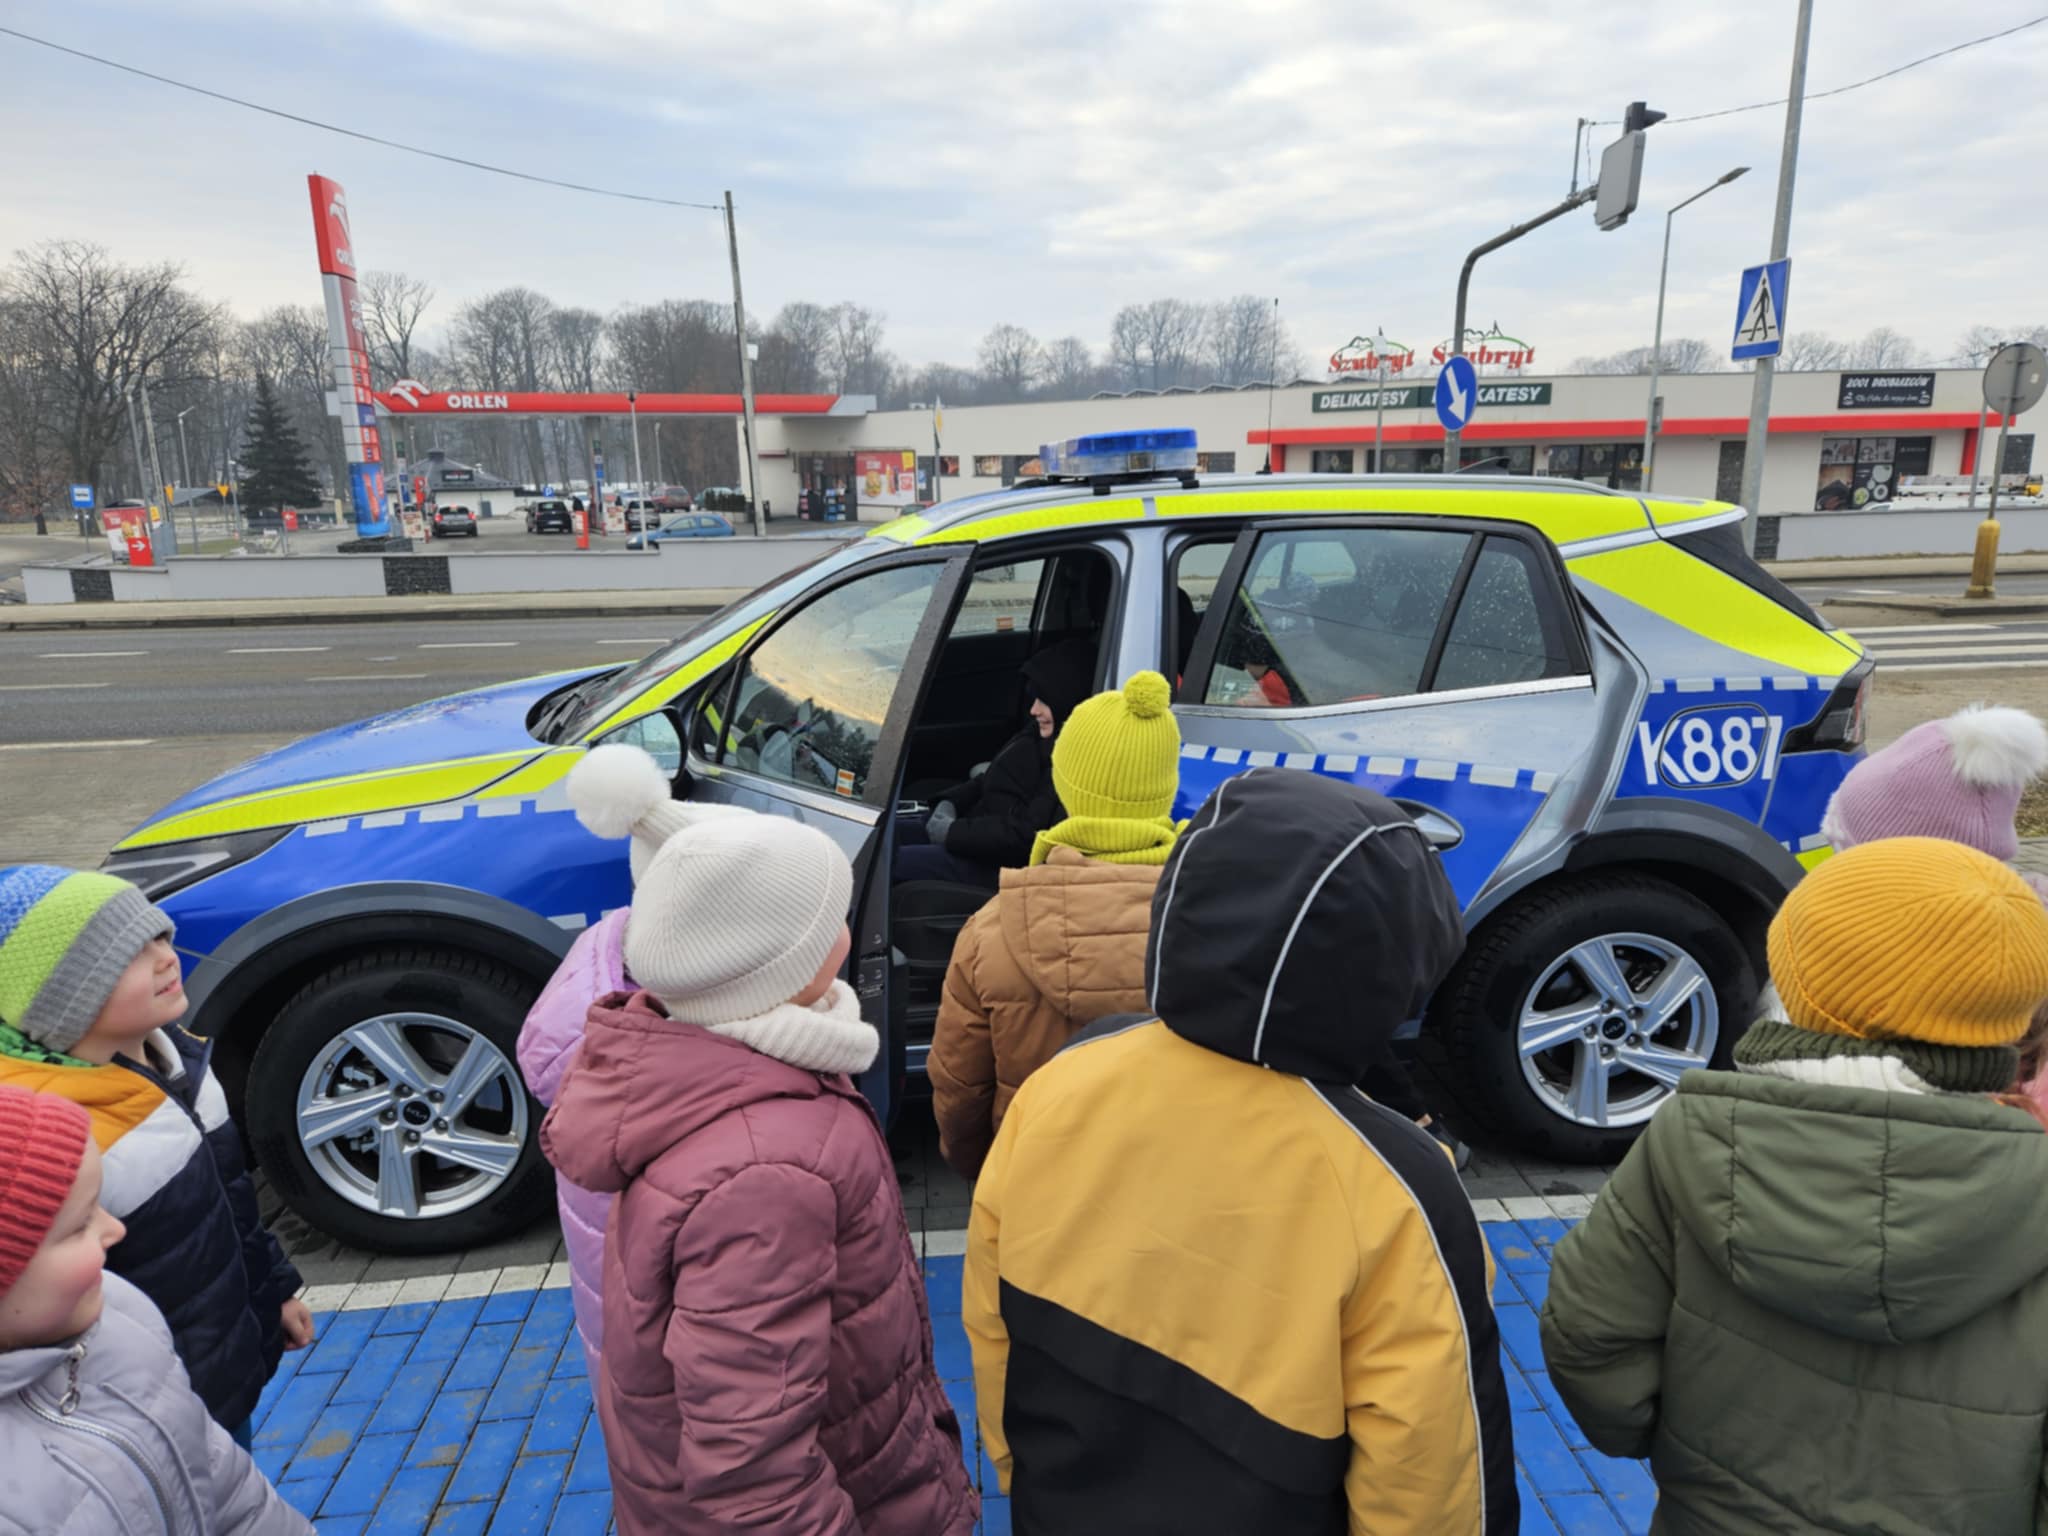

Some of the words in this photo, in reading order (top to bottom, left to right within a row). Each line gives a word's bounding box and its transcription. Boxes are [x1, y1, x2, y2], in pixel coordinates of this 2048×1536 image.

[1430, 344, 1536, 370] Subryt
[447, 394, 509, 409] ORLEN
[1320, 390, 1411, 409] DELIKATESY
[1431, 386, 1542, 404] KATESY
[1637, 715, 1783, 785] K887
